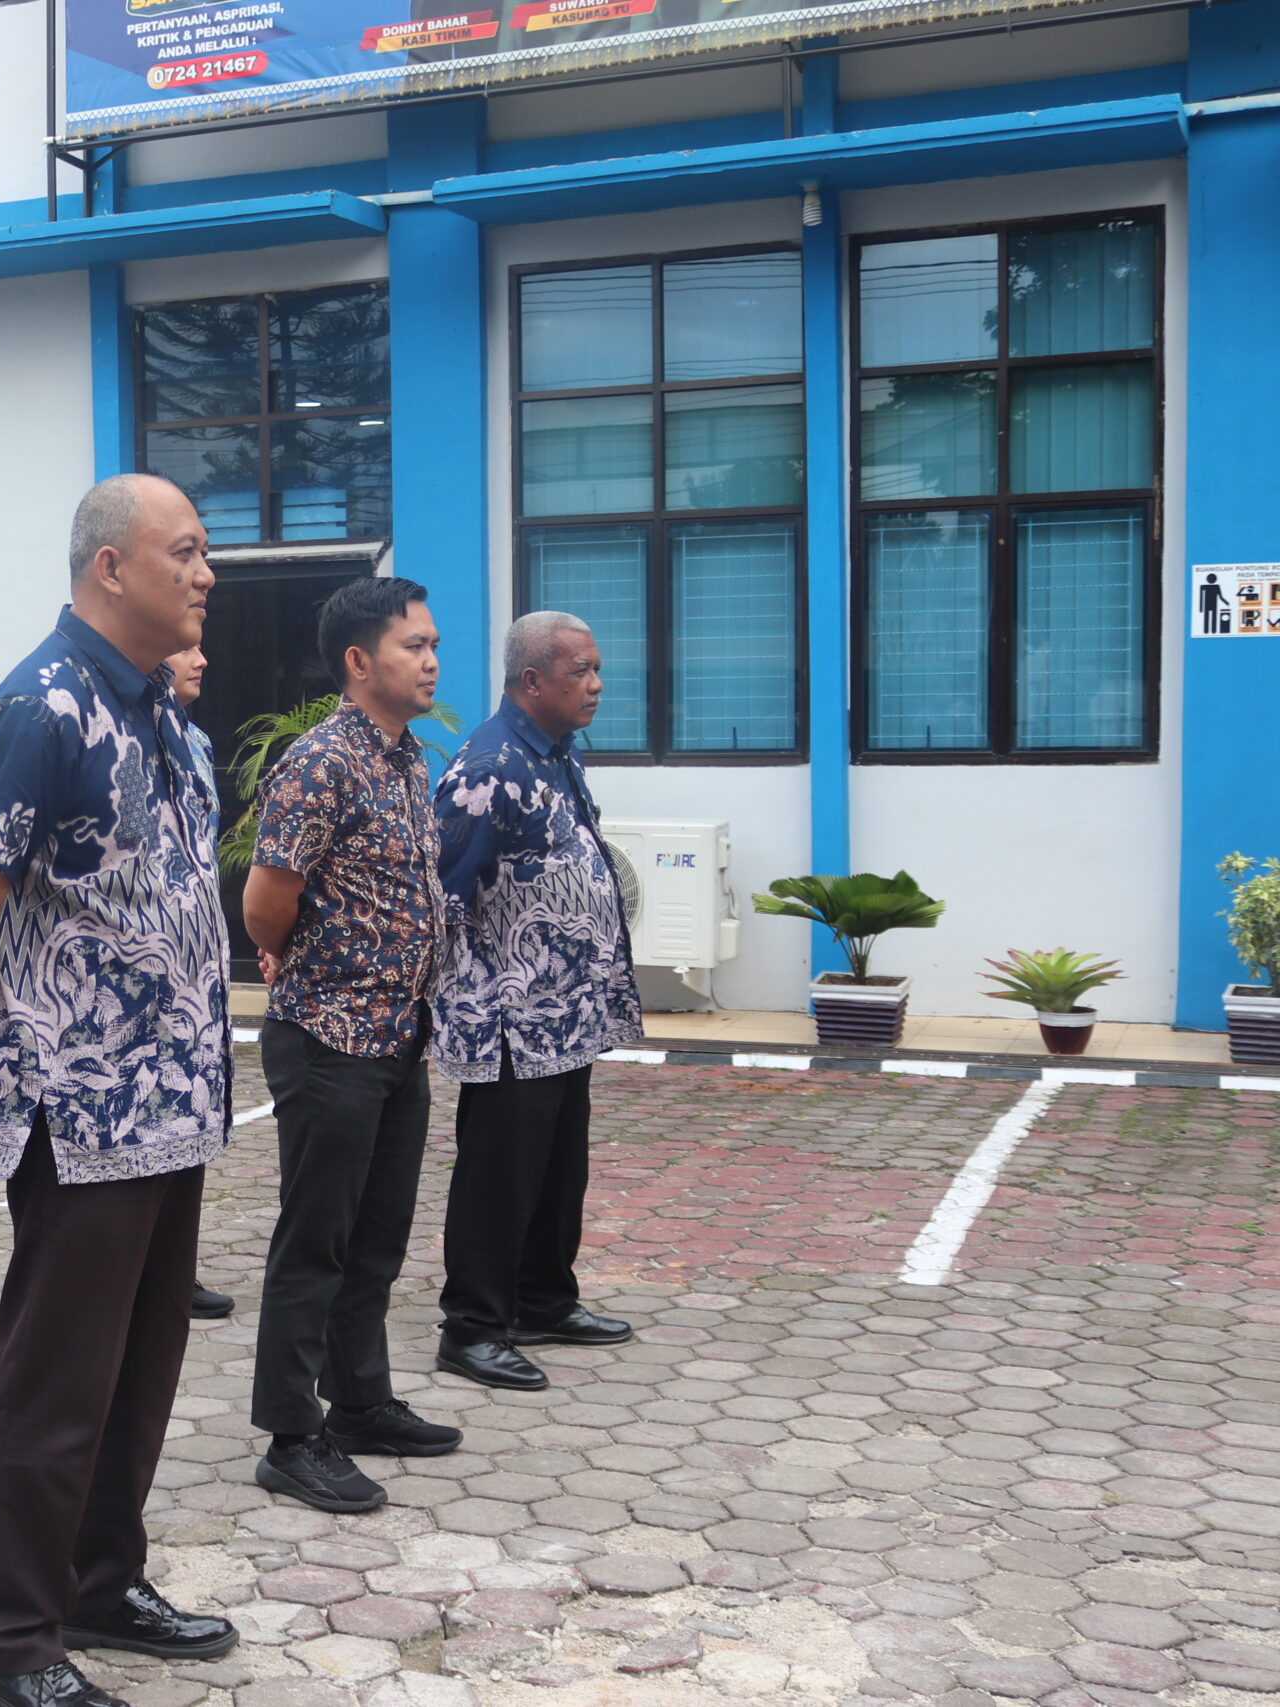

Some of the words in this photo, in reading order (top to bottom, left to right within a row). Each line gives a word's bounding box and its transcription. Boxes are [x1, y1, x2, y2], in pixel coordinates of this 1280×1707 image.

[127, 13, 211, 35] PERTANYAAN,
[214, 2, 284, 22] ASPRIRASI,
[552, 8, 610, 24] KASUBAG
[614, 4, 630, 15] TU
[137, 30, 180, 48] KRITIK
[182, 30, 192, 41] &
[195, 18, 273, 39] PENGADUAN
[382, 23, 424, 37] DONNY
[427, 16, 468, 31] BAHAR
[401, 34, 431, 47] KASI
[436, 29, 472, 42] TIKIM
[157, 45, 192, 59] ANDA
[195, 36, 249, 54] MELALUI
[153, 64, 197, 84] 0724
[201, 56, 257, 78] 21467
